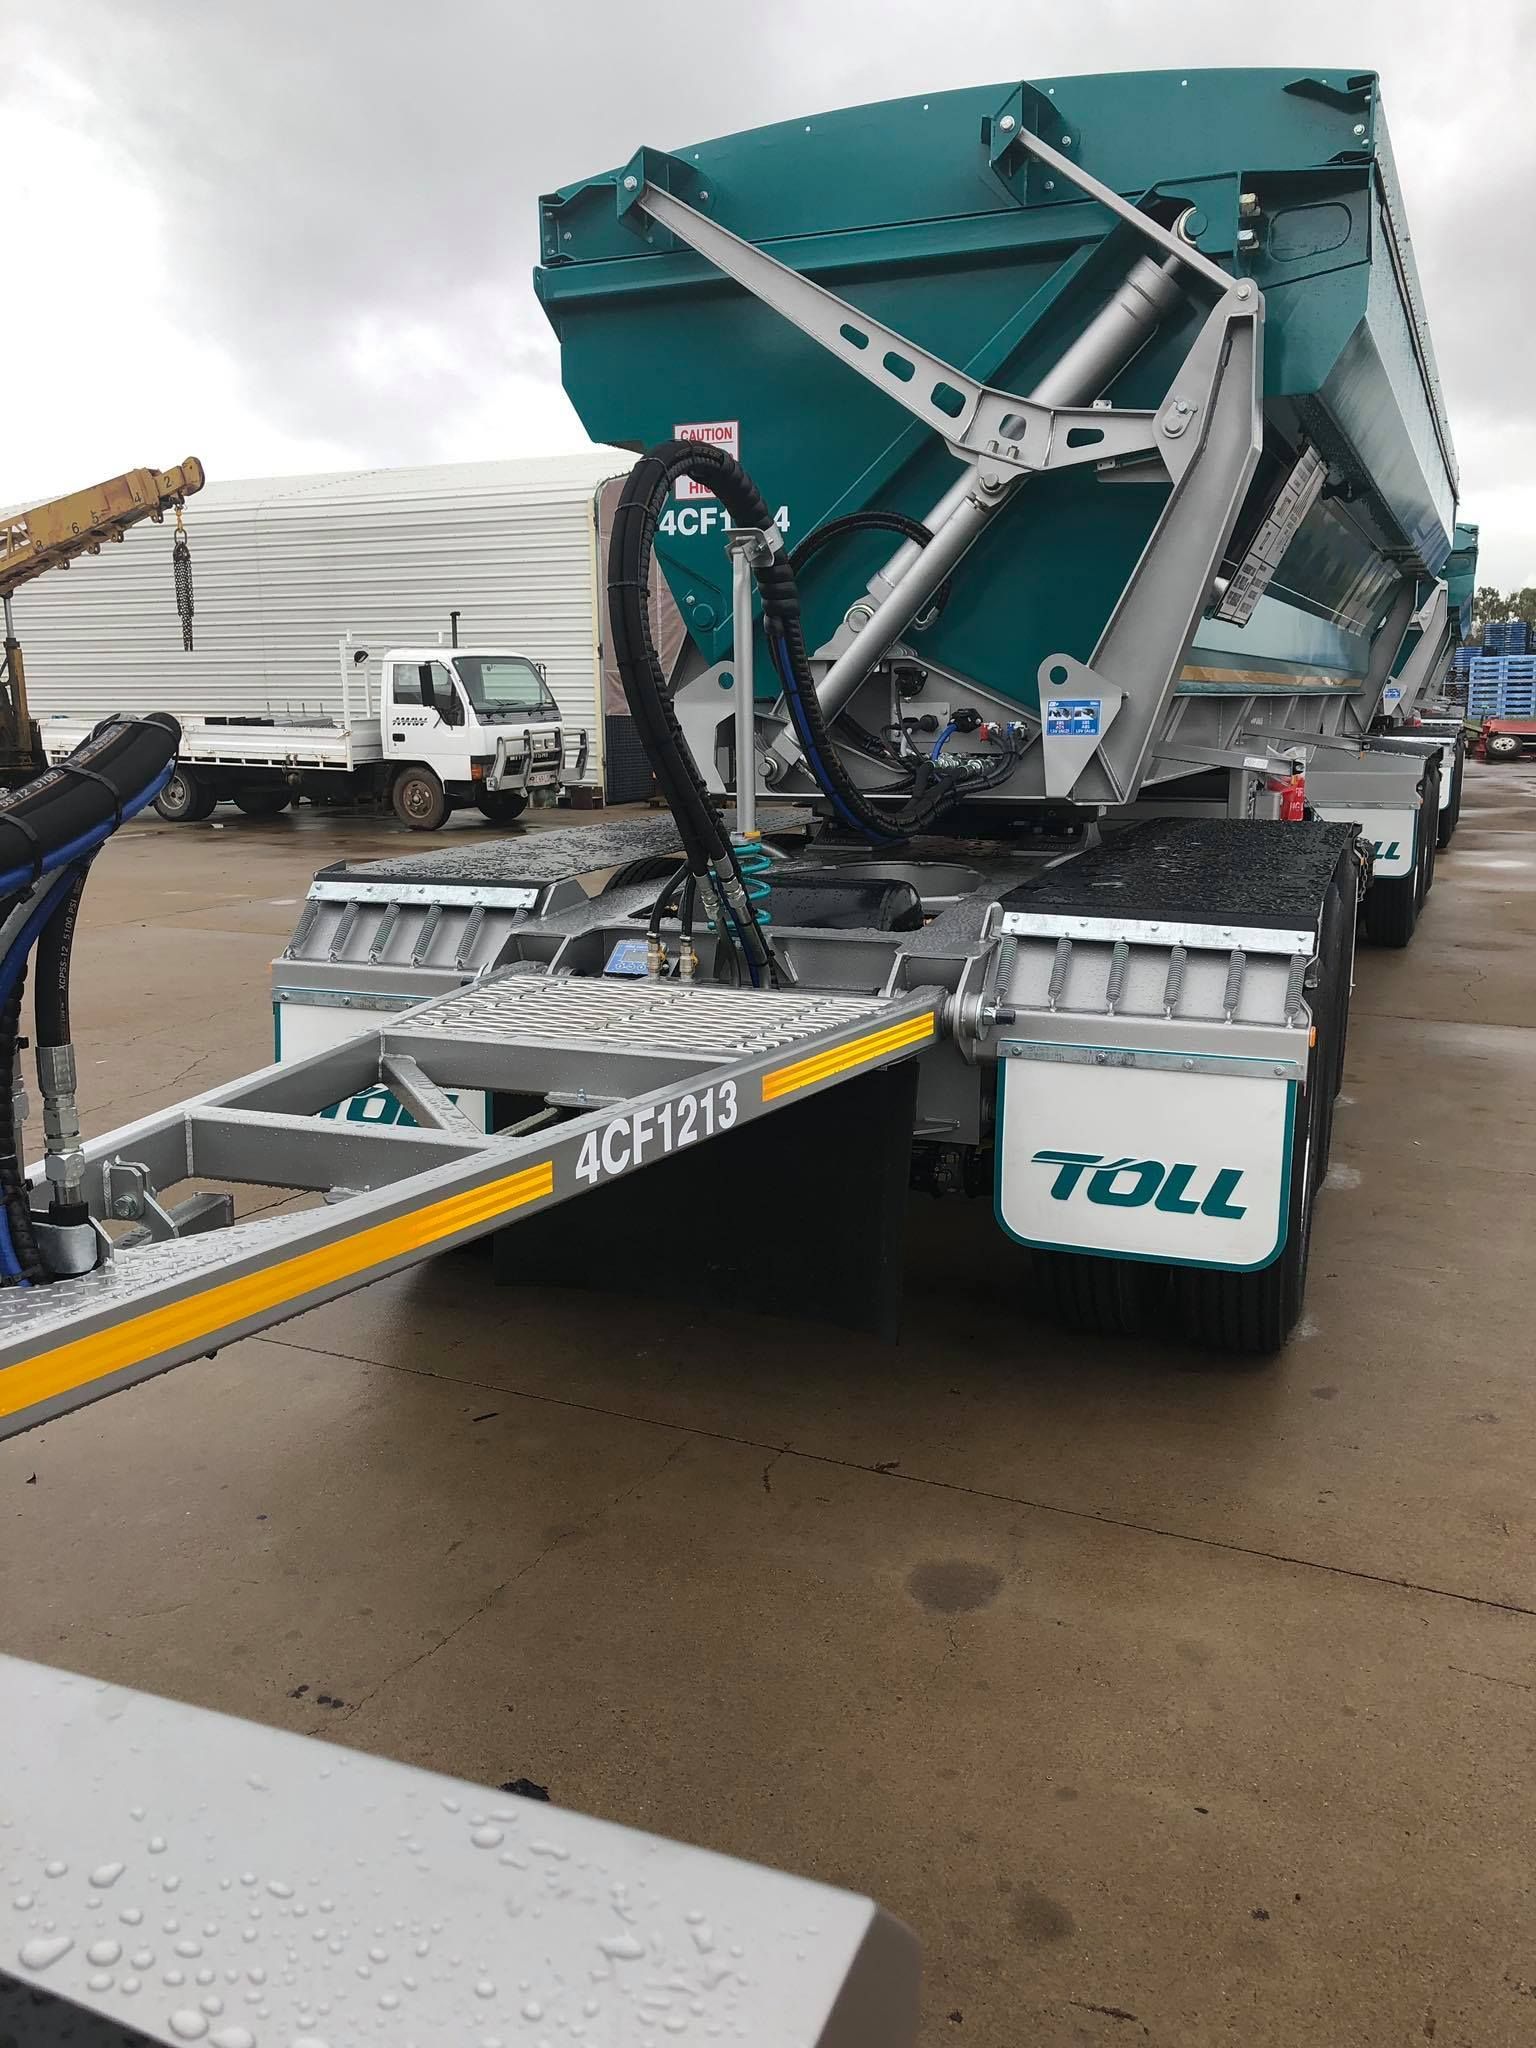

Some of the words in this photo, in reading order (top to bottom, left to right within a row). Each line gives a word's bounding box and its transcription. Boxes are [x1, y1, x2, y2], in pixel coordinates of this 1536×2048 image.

[681, 427, 732, 441] CAUTION
[163, 476, 173, 489] 2
[71, 522, 80, 534] 6
[659, 505, 791, 536] 4CF14
[67, 899, 78, 915] PSI
[63, 917, 73, 940] 5100
[575, 1080, 738, 1184] 4CF1213
[1031, 1151, 1248, 1220] TOLL
